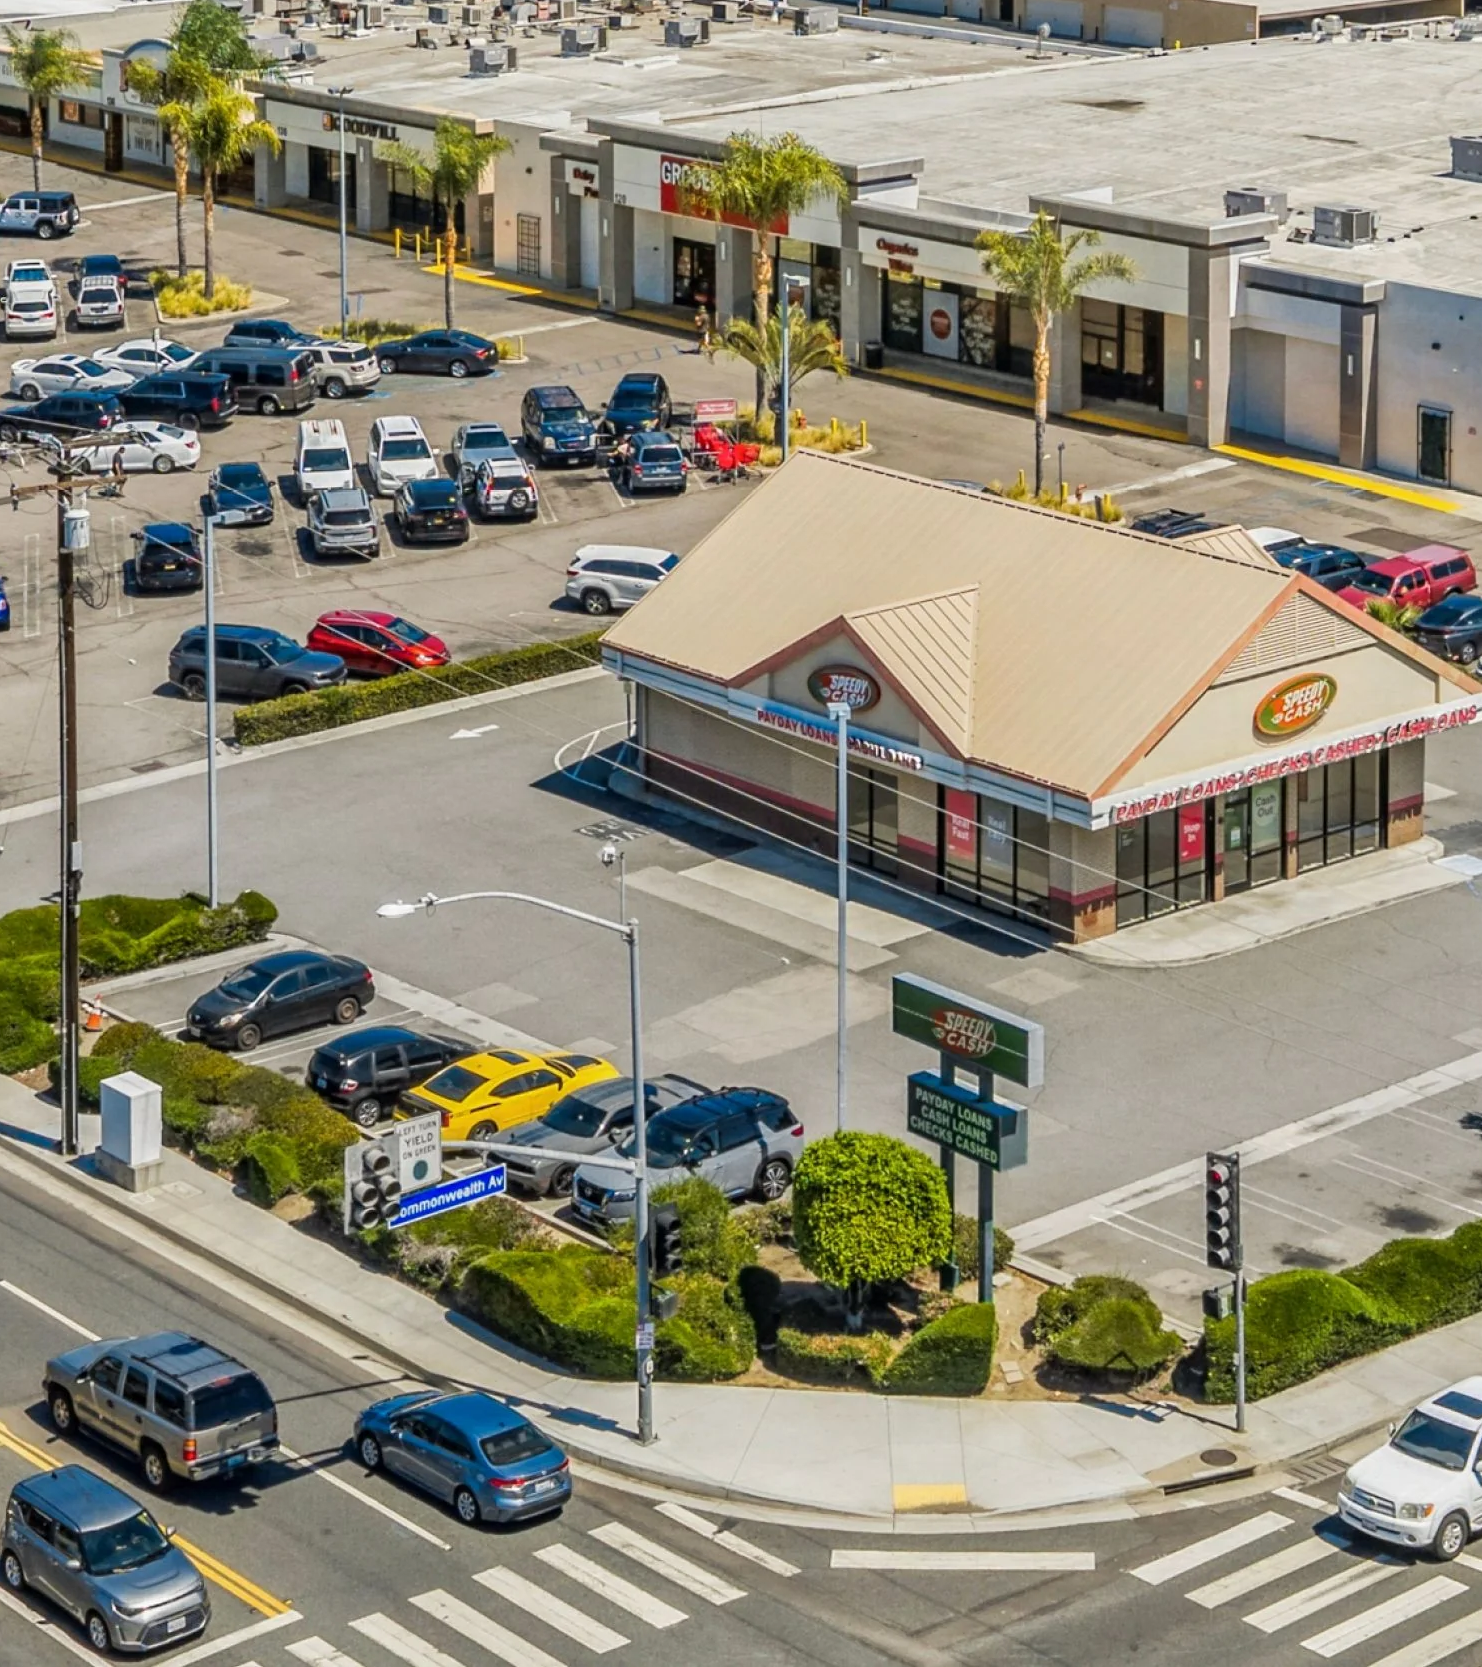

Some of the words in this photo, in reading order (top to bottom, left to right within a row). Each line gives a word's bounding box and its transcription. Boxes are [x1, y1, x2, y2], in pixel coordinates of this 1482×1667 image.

[830, 674, 869, 694] SPEEDY
[831, 691, 866, 704] CASH
[1283, 679, 1328, 712] SPEEDY
[1283, 697, 1324, 724] CASH
[757, 709, 799, 733] PAYDAY
[800, 724, 839, 746] LOANS
[1116, 790, 1178, 822] PAYDAY
[1182, 774, 1236, 804] LOANS
[1245, 752, 1313, 785] CHECKS
[1314, 734, 1376, 765] CASHED
[1385, 716, 1432, 745] CASH
[1431, 705, 1478, 730] LOANS
[1255, 794, 1277, 808] Cash
[1257, 806, 1274, 818] Out
[943, 1010, 994, 1043] SPEEDY
[946, 1032, 989, 1055] CASH
[915, 1088, 955, 1118] PAYDAY
[957, 1103, 993, 1132] LOANS
[399, 1123, 416, 1135] LEFT
[419, 1120, 438, 1131] TURN
[920, 1105, 951, 1128] CASH
[952, 1118, 987, 1145] LOANS
[403, 1148, 413, 1159] ON
[414, 1144, 437, 1157] GREEN
[404, 1133, 434, 1148] YIELD
[910, 1114, 953, 1146] CHECKS
[955, 1136, 998, 1164] CASHED
[399, 1179, 486, 1218] ommonwealth
[487, 1173, 504, 1190] Av
